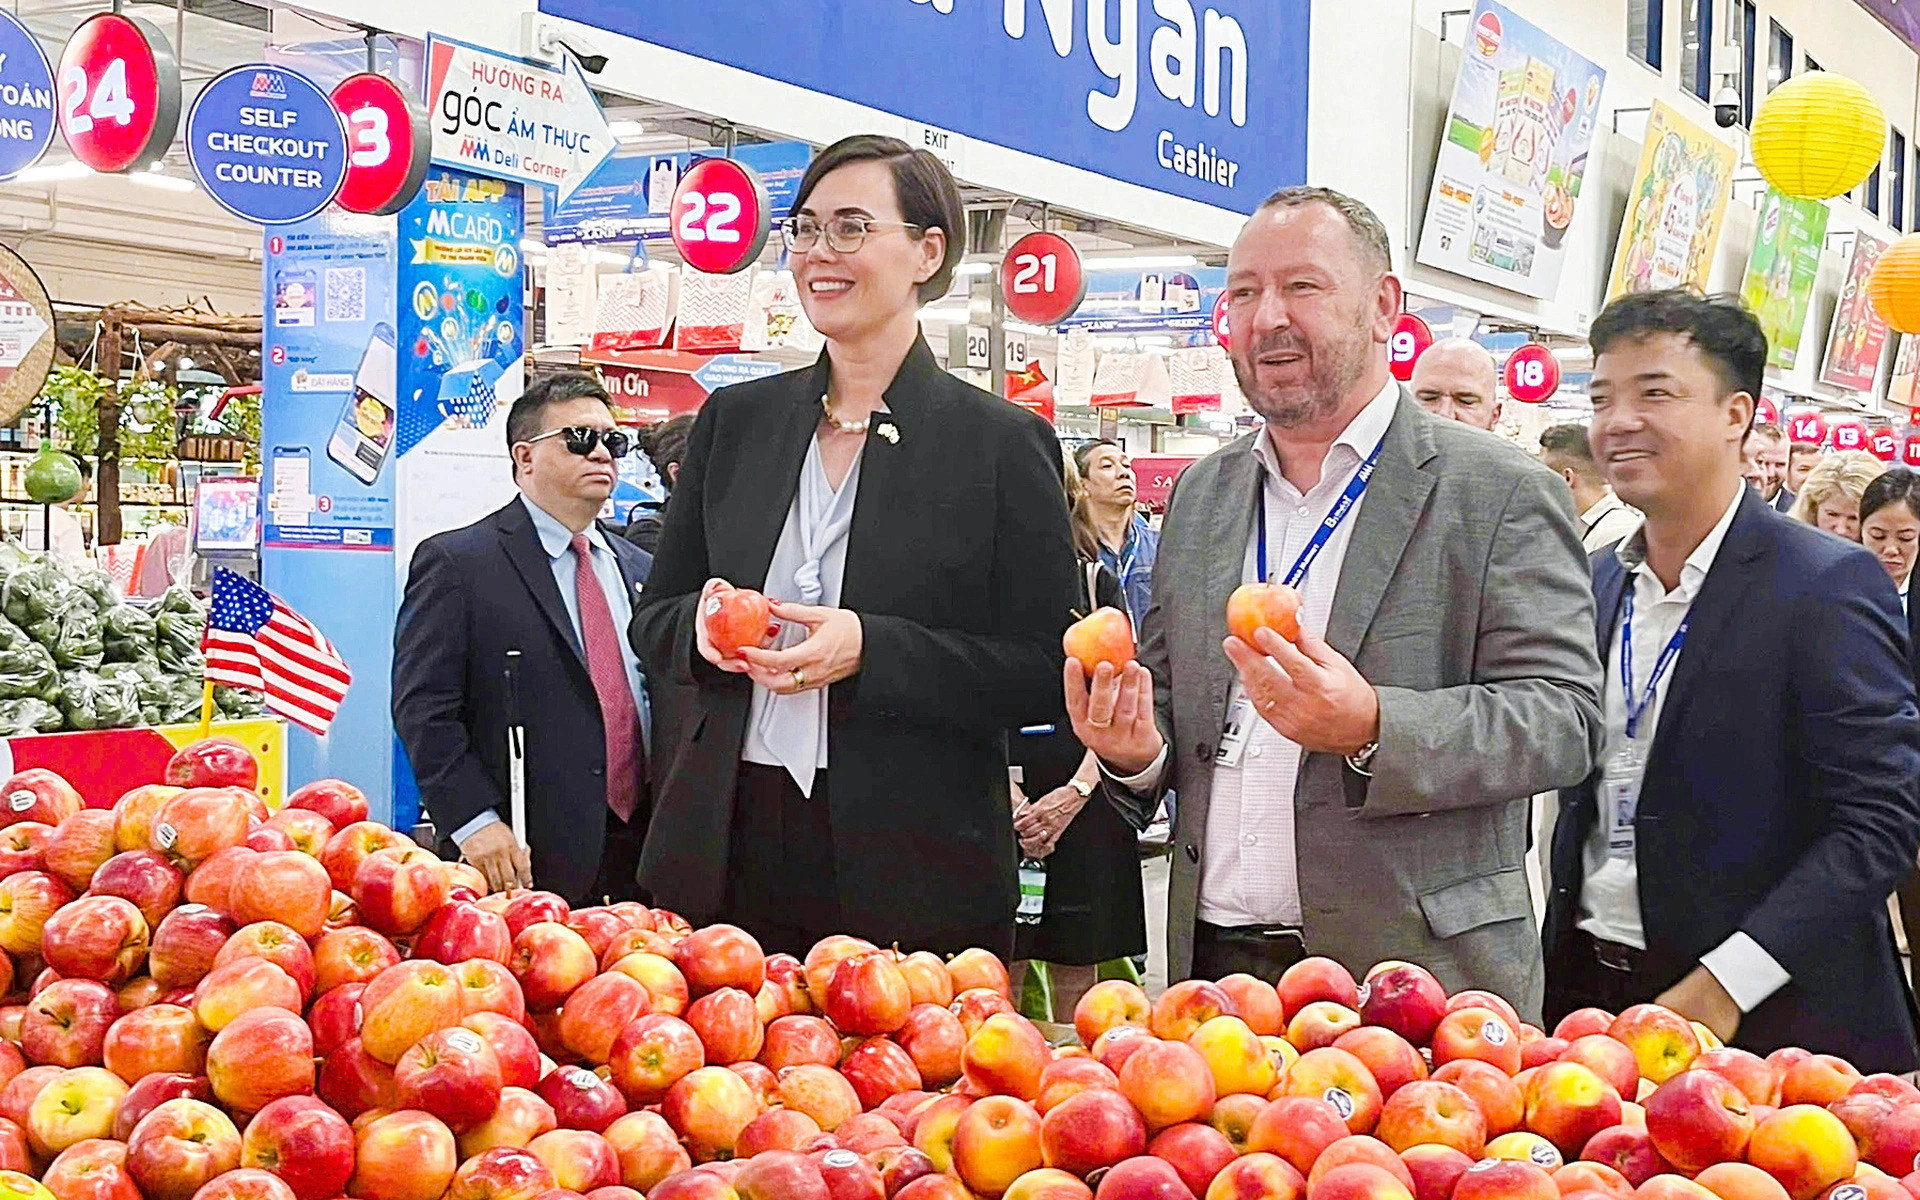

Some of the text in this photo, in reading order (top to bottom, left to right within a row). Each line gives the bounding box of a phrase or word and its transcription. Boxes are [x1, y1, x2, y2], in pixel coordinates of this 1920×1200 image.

[0, 82, 51, 109] OÁN
[64, 57, 135, 135] 24
[540, 80, 564, 103] RA
[240, 106, 297, 128] SELF
[442, 86, 502, 135] góc
[541, 123, 591, 155] THỰC
[207, 131, 329, 159] CHECKOUT
[924, 129, 948, 149] EXIT
[495, 149, 519, 169] Deli
[522, 156, 568, 179] Corner
[1157, 130, 1238, 189] Cashier
[215, 162, 323, 188] COUNTER
[679, 191, 741, 242] 22
[272, 238, 280, 255] 1
[1013, 253, 1057, 294] 21
[273, 347, 284, 364] 2
[968, 335, 988, 358] 20
[1006, 341, 1025, 363] 19
[1514, 359, 1544, 387] 18
[1795, 419, 1817, 438] 14
[1837, 427, 1859, 446] 13
[1873, 436, 1894, 452] 12
[319, 497, 330, 513] 3
